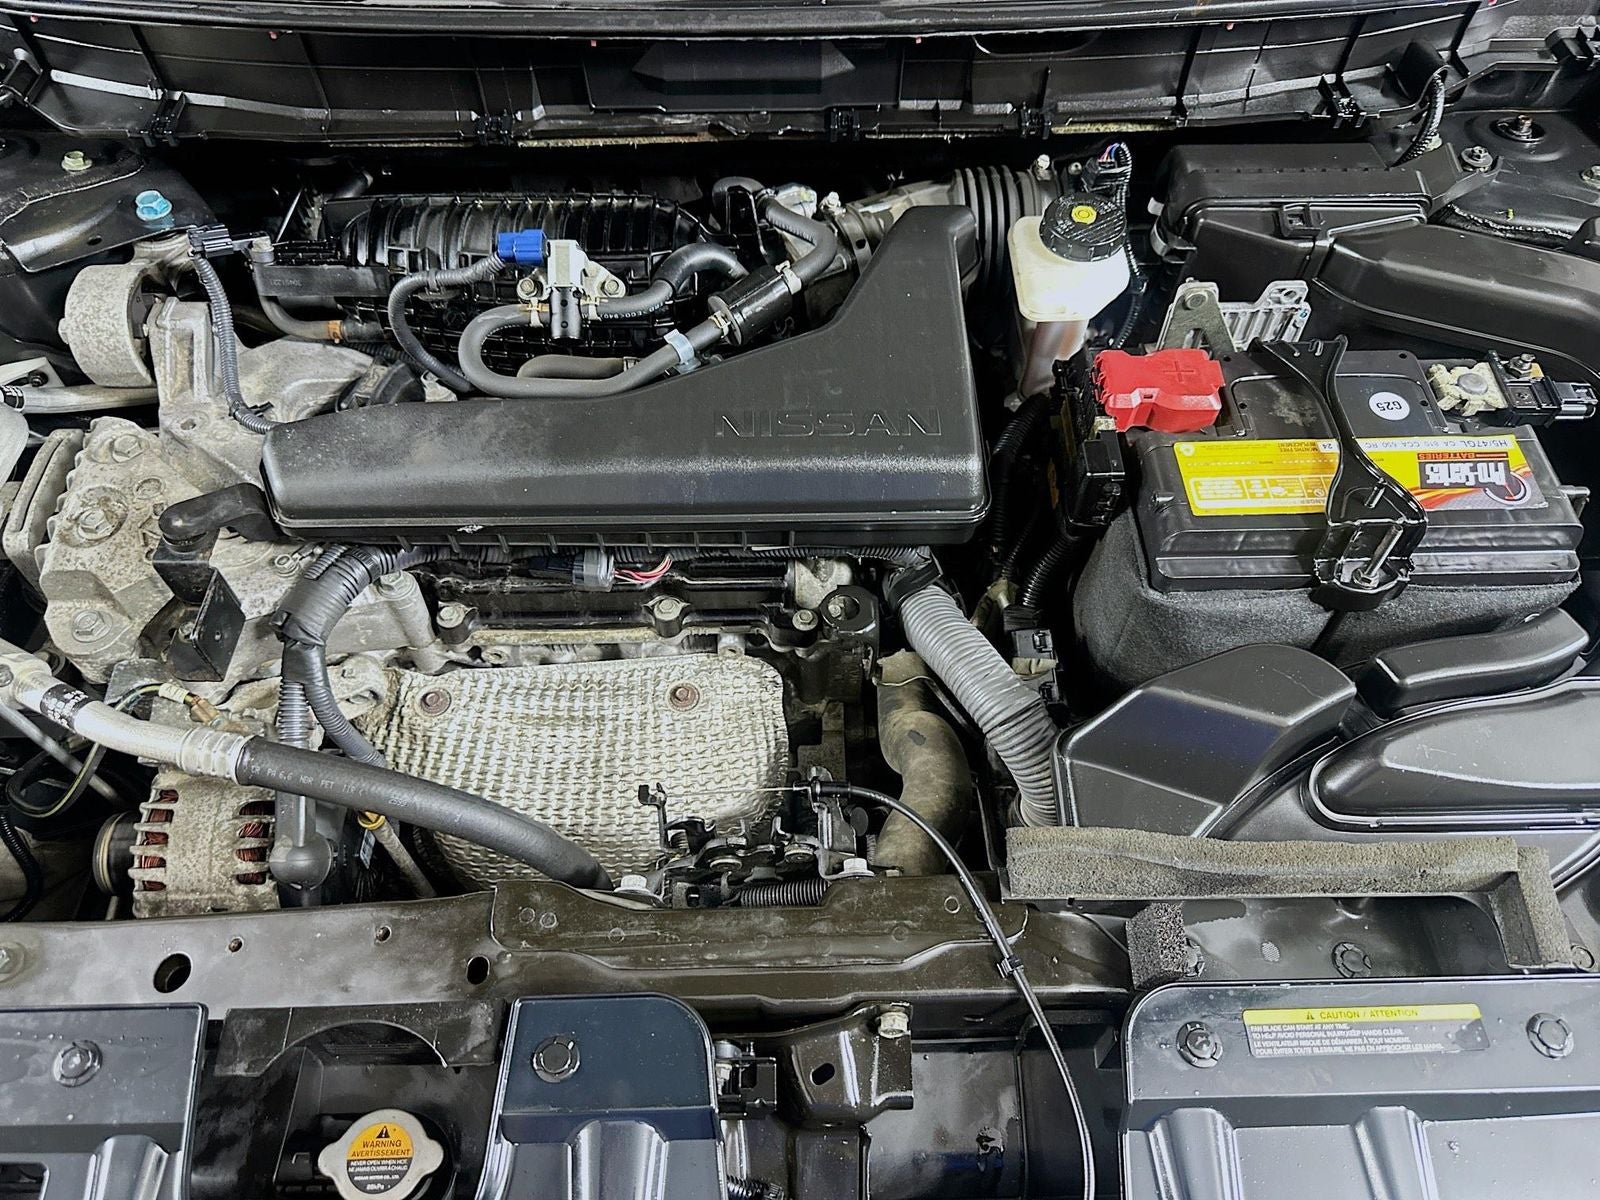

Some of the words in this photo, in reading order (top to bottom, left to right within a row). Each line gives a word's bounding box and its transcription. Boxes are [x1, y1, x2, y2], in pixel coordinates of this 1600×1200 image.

[1376, 400, 1402, 411] G25
[714, 409, 942, 437] NISSAN
[1418, 452, 1476, 460] BATTERIES
[1424, 462, 1506, 487] Pro-Series
[1319, 1010, 1360, 1019] CAUTION
[1370, 1009, 1418, 1018] ATTENTION
[362, 1140, 402, 1149] WARNING
[351, 1149, 411, 1157] AVERTISSEMENT
